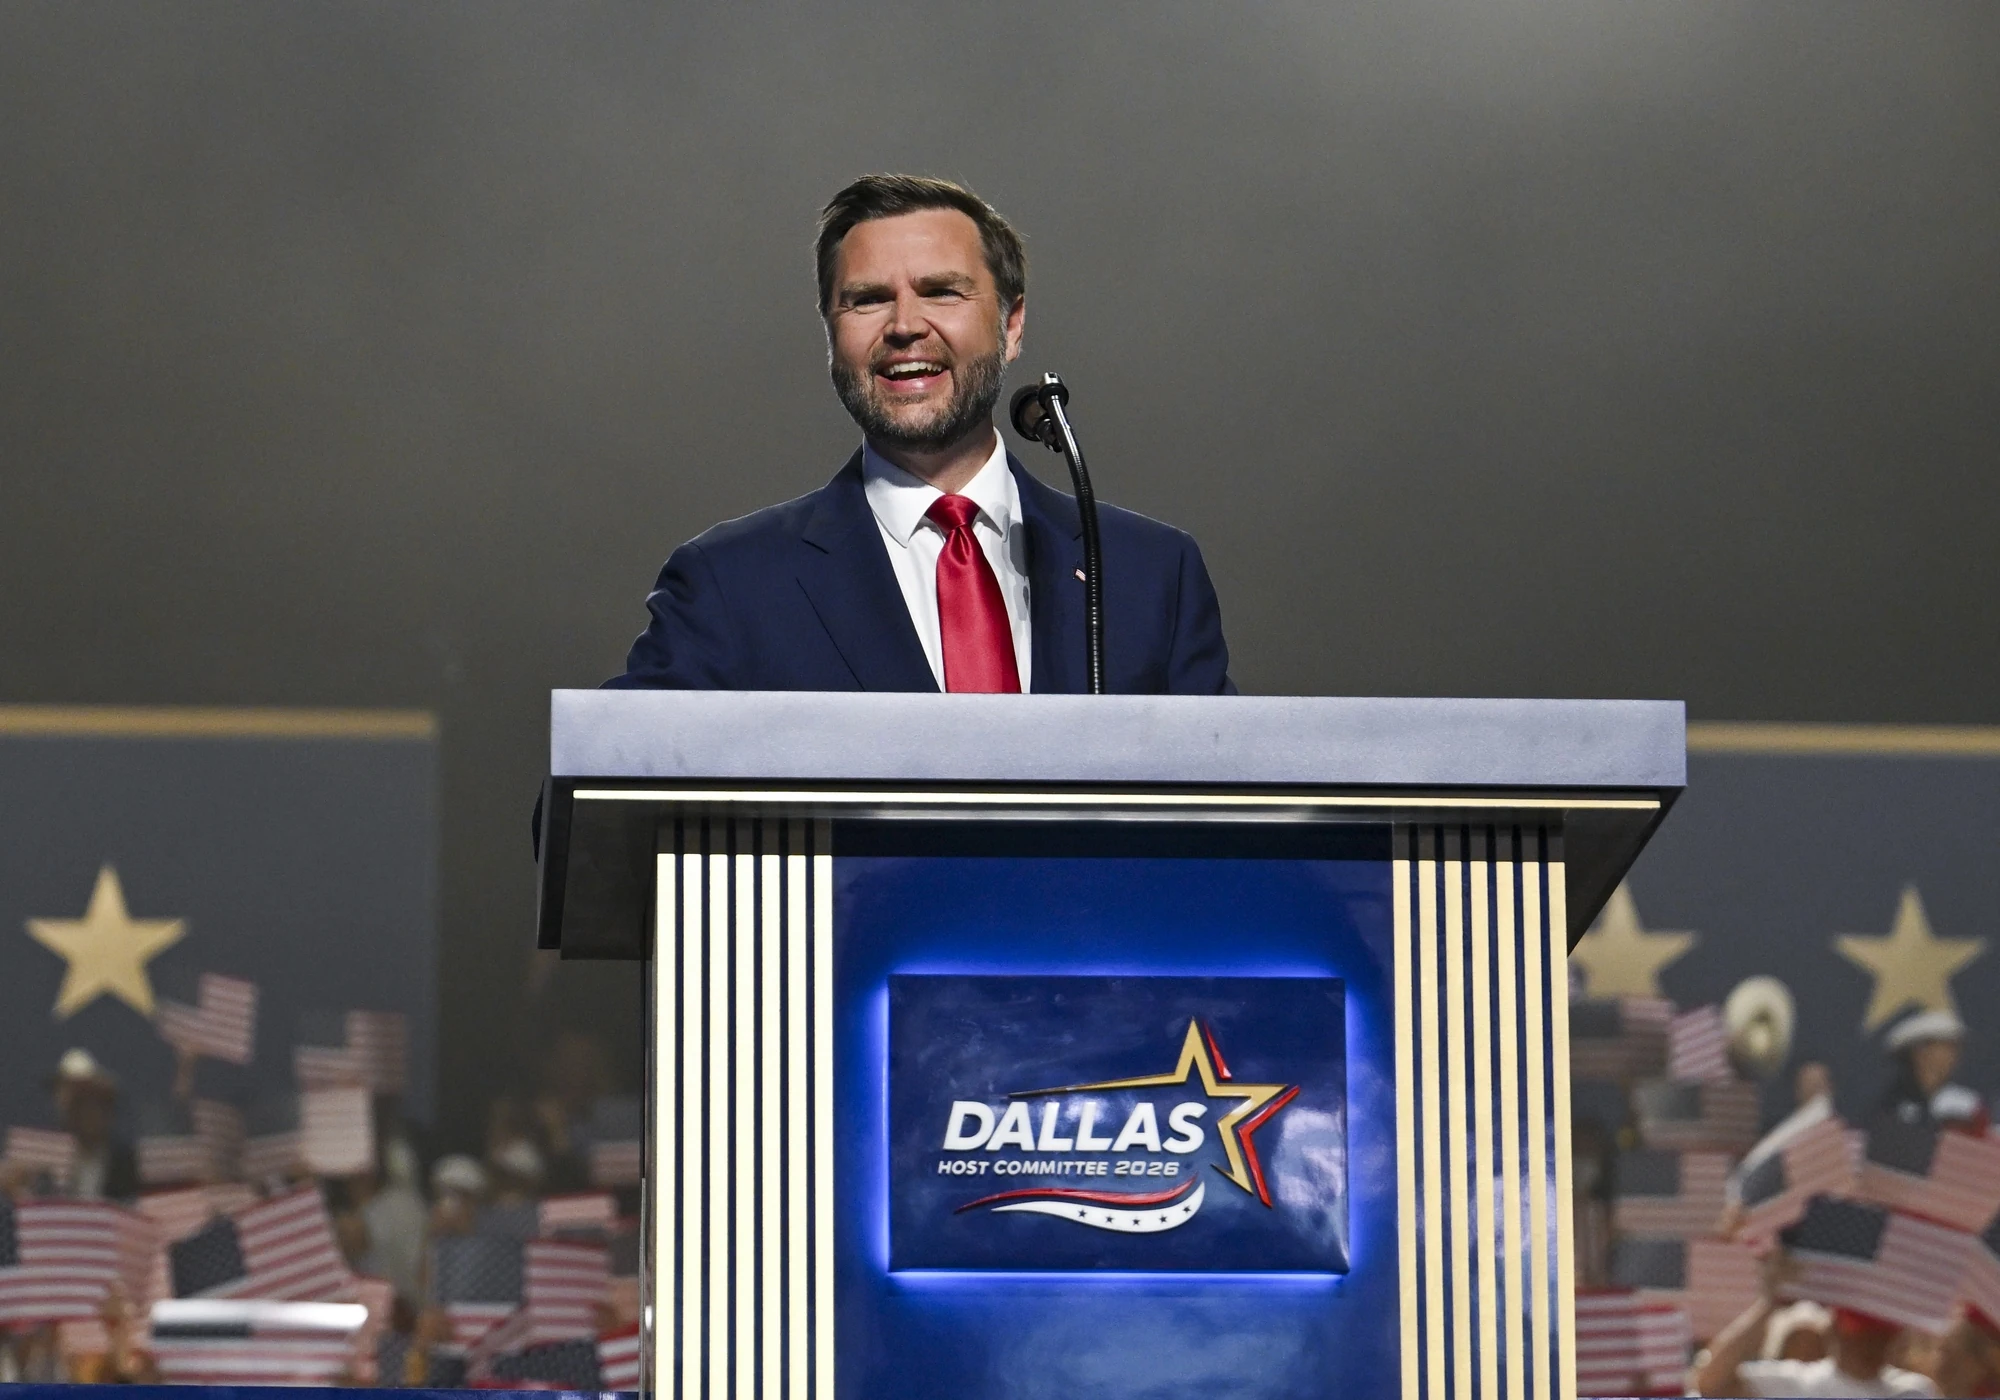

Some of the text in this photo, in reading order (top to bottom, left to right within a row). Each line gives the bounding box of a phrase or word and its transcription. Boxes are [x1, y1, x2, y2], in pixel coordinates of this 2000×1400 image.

[943, 1101, 1208, 1153] DALLAS
[938, 1160, 1180, 1176] HOST COMMITTEE 2026
